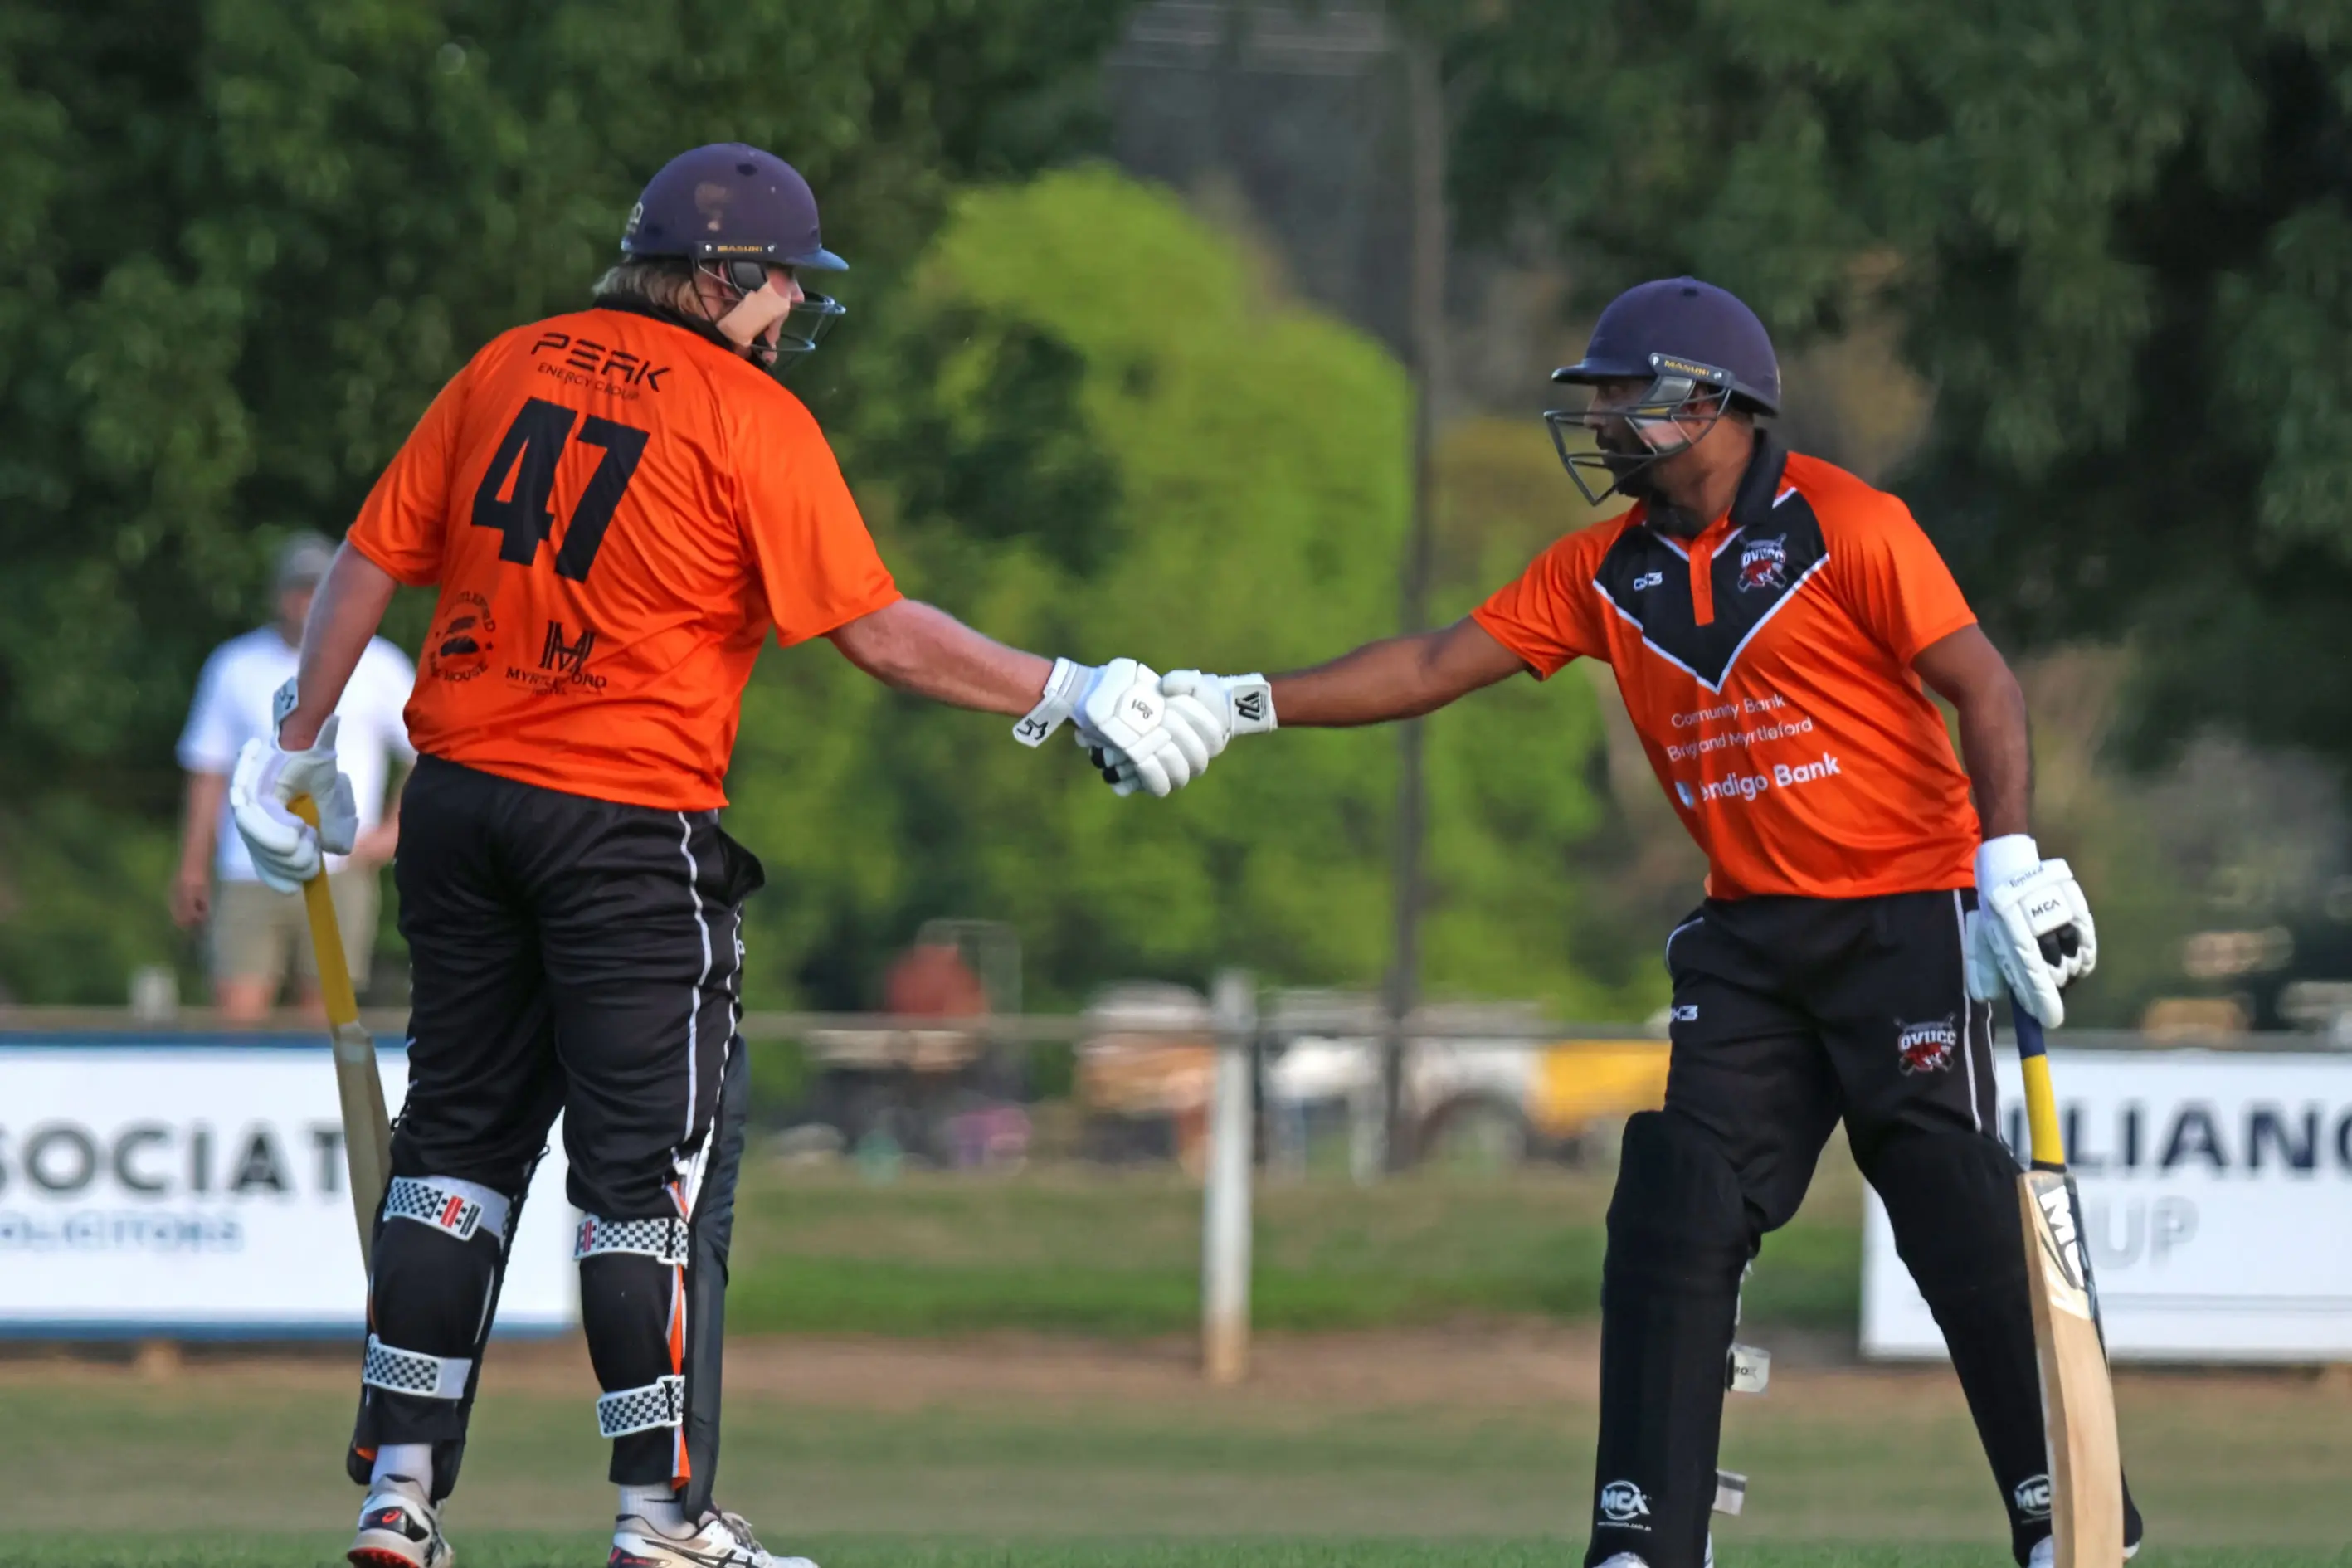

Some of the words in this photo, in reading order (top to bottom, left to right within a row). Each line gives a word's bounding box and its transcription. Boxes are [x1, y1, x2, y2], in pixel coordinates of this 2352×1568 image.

[530, 333, 671, 392] PEAK
[471, 396, 650, 583] 47
[1743, 694, 1786, 713] Bank
[1729, 717, 1814, 749] Myrtleford
[1773, 752, 1841, 788] Bank
[2031, 898, 2061, 918] MCA
[0, 1122, 353, 1200] OCIAT
[2010, 1104, 2352, 1173] LLIAN
[2086, 1195, 2201, 1273] UP
[1600, 1488, 1651, 1515] MCA
